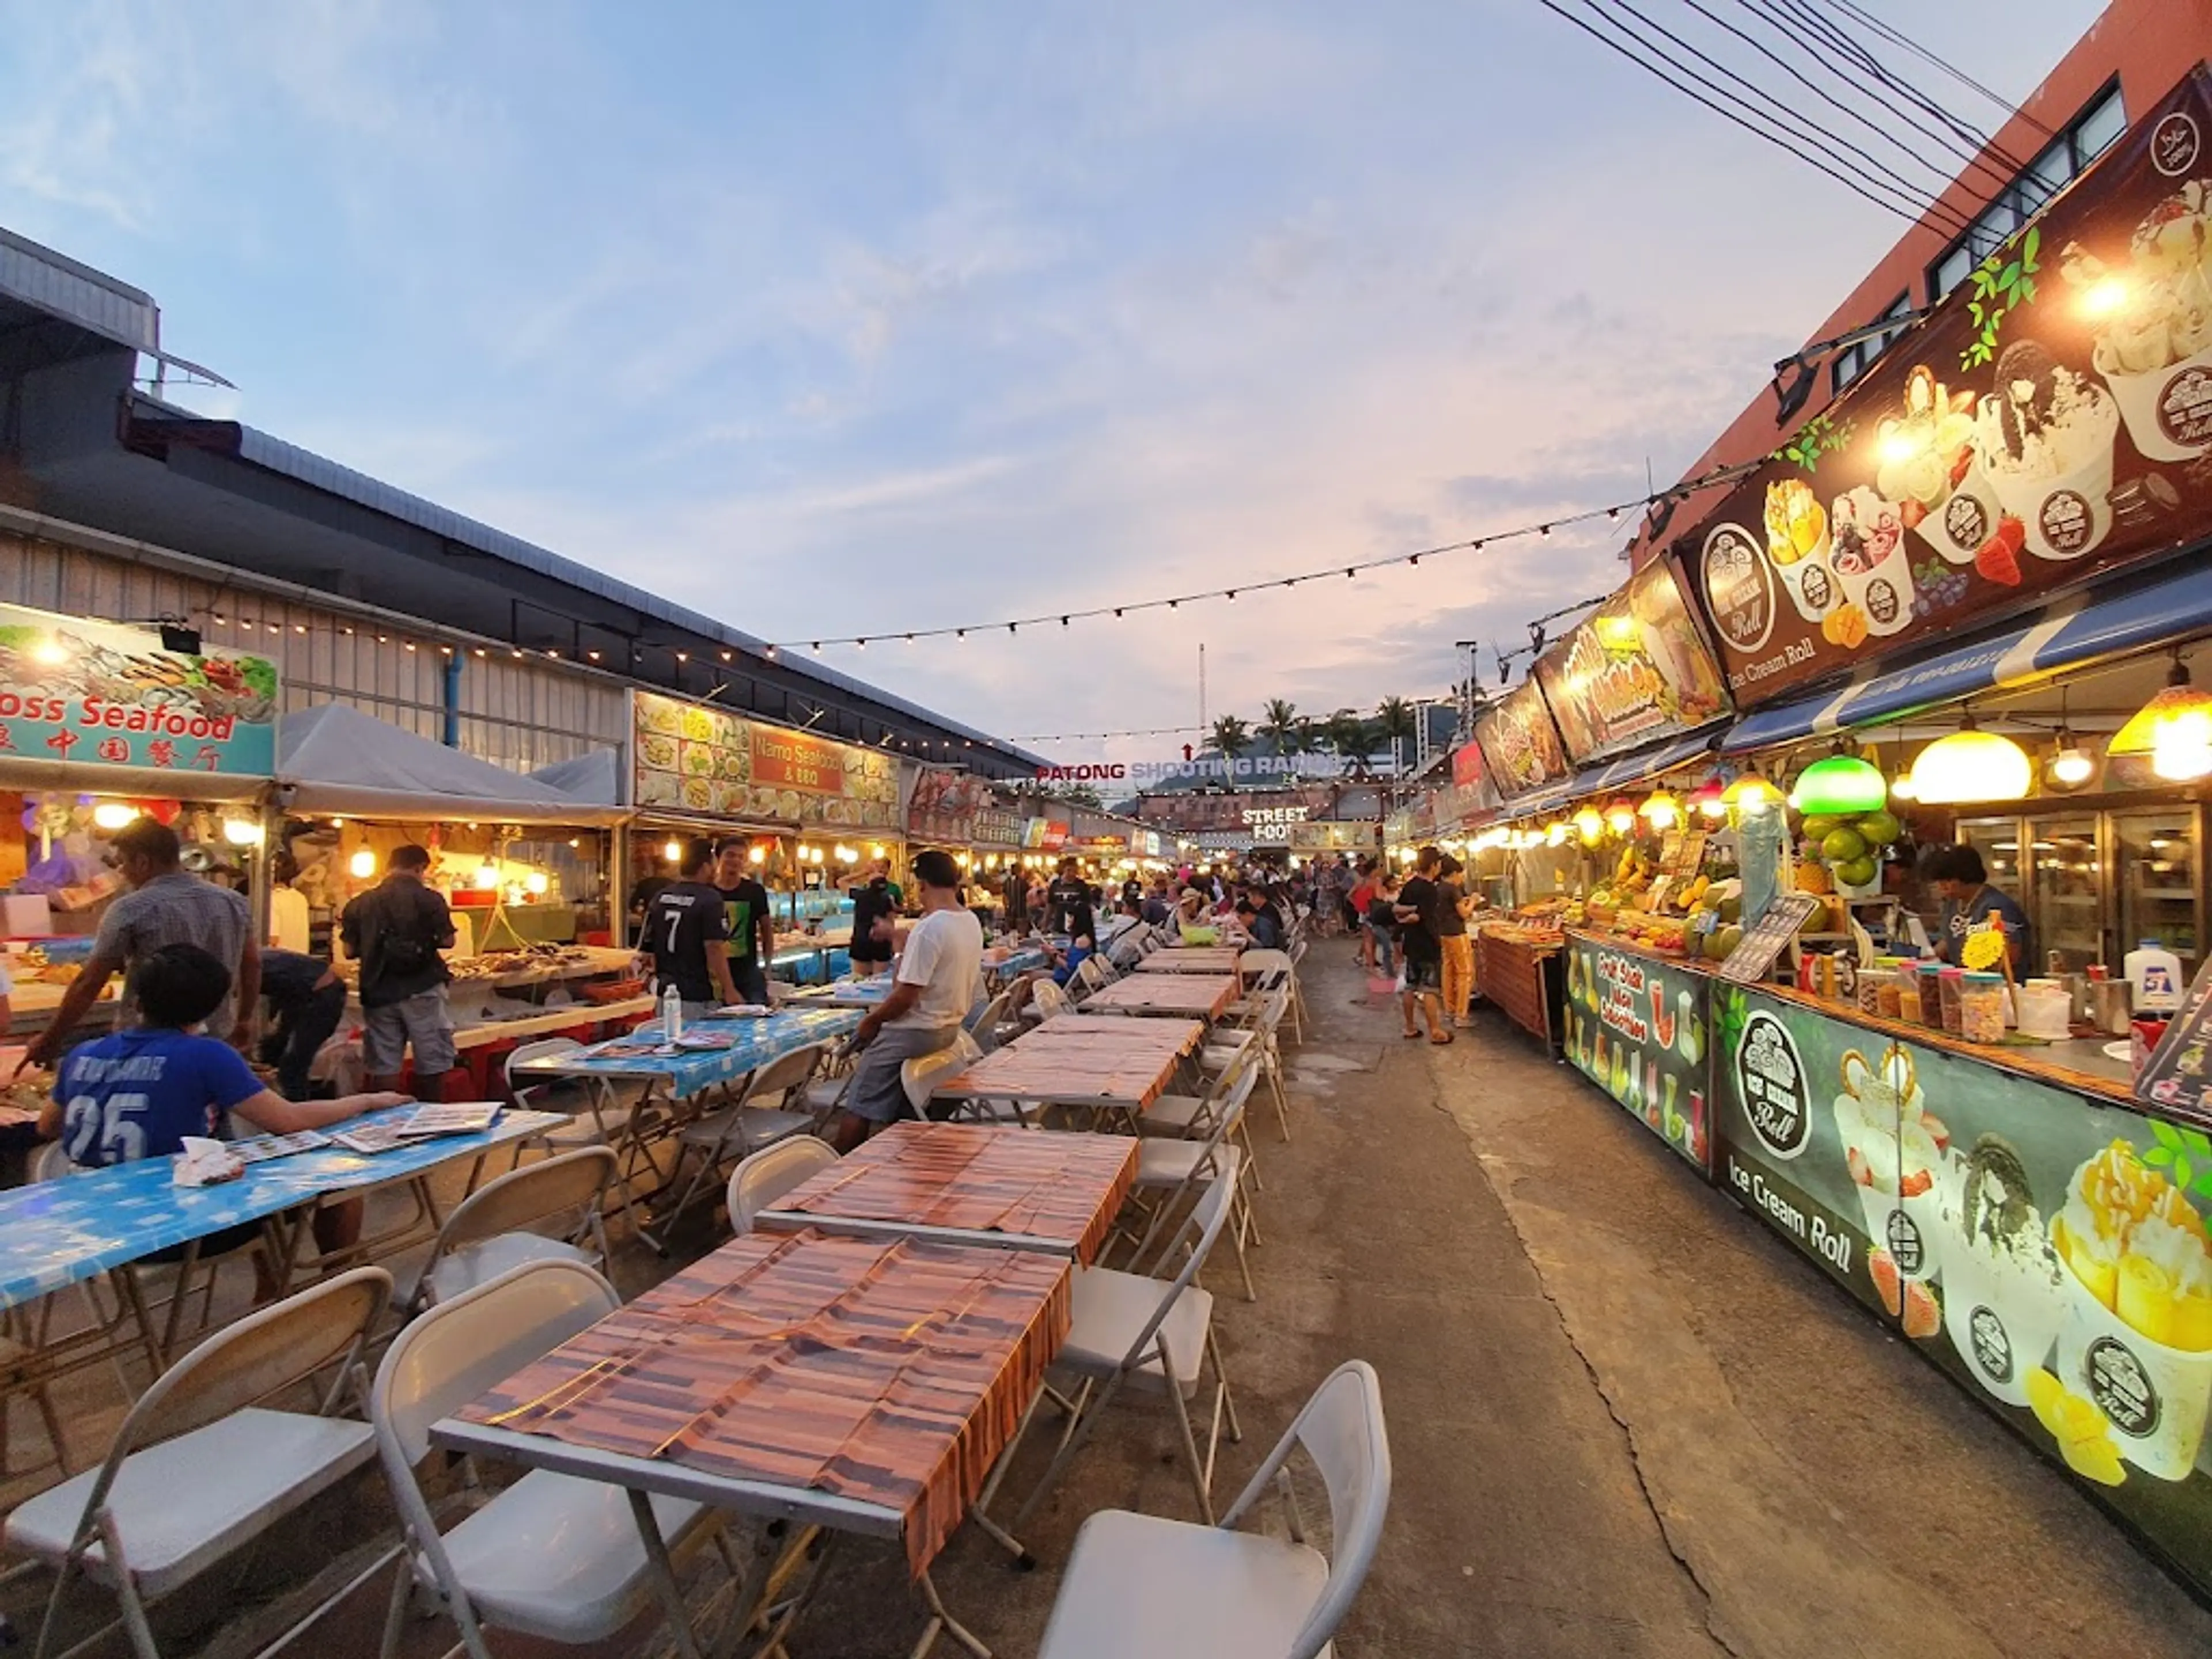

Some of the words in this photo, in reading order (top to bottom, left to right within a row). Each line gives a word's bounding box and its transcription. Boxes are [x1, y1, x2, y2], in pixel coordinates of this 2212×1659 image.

[1727, 672, 1747, 690] Ice
[1745, 654, 1788, 681] Cream
[1785, 637, 1816, 664] Roll
[79, 694, 236, 741] Seafood
[1037, 764, 1124, 782] PATONG
[1130, 758, 1251, 778] SHOOTING
[1241, 806, 1309, 824] STREET
[665, 910, 682, 954] 7
[65, 1092, 150, 1163] 25
[1753, 1101, 1796, 1143] Roll
[1729, 1154, 1749, 1193] Ice
[1753, 1175, 1805, 1238] Cream
[1810, 1215, 1851, 1274] Roll
